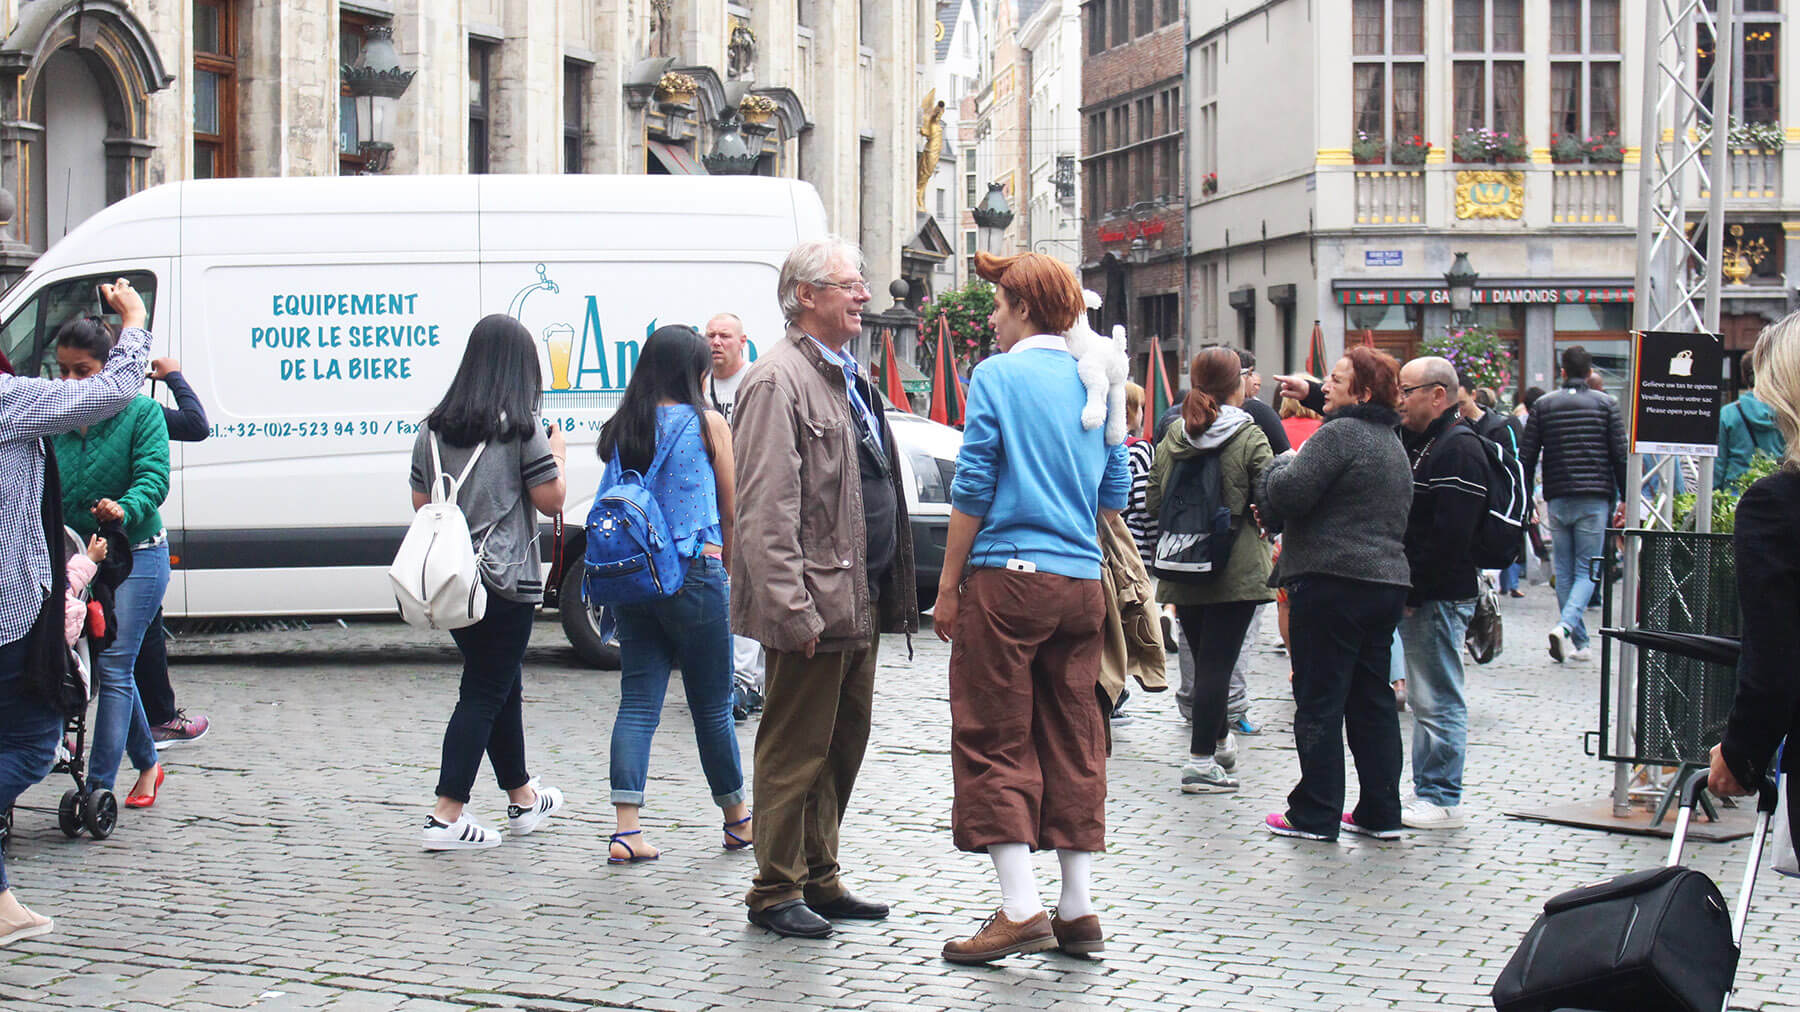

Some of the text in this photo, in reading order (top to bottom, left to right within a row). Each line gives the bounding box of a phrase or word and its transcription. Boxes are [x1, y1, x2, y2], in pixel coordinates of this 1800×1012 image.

[273, 293, 418, 316] EQUIPEMENT
[1492, 288, 1558, 304] DIAMONDS
[251, 324, 440, 349] POUR LE SERVICE
[280, 357, 412, 381] DE LA BIERE
[1646, 406, 1711, 417] Please open your bag
[334, 421, 354, 436] 94
[359, 421, 379, 435] 30
[397, 420, 421, 435] Fax
